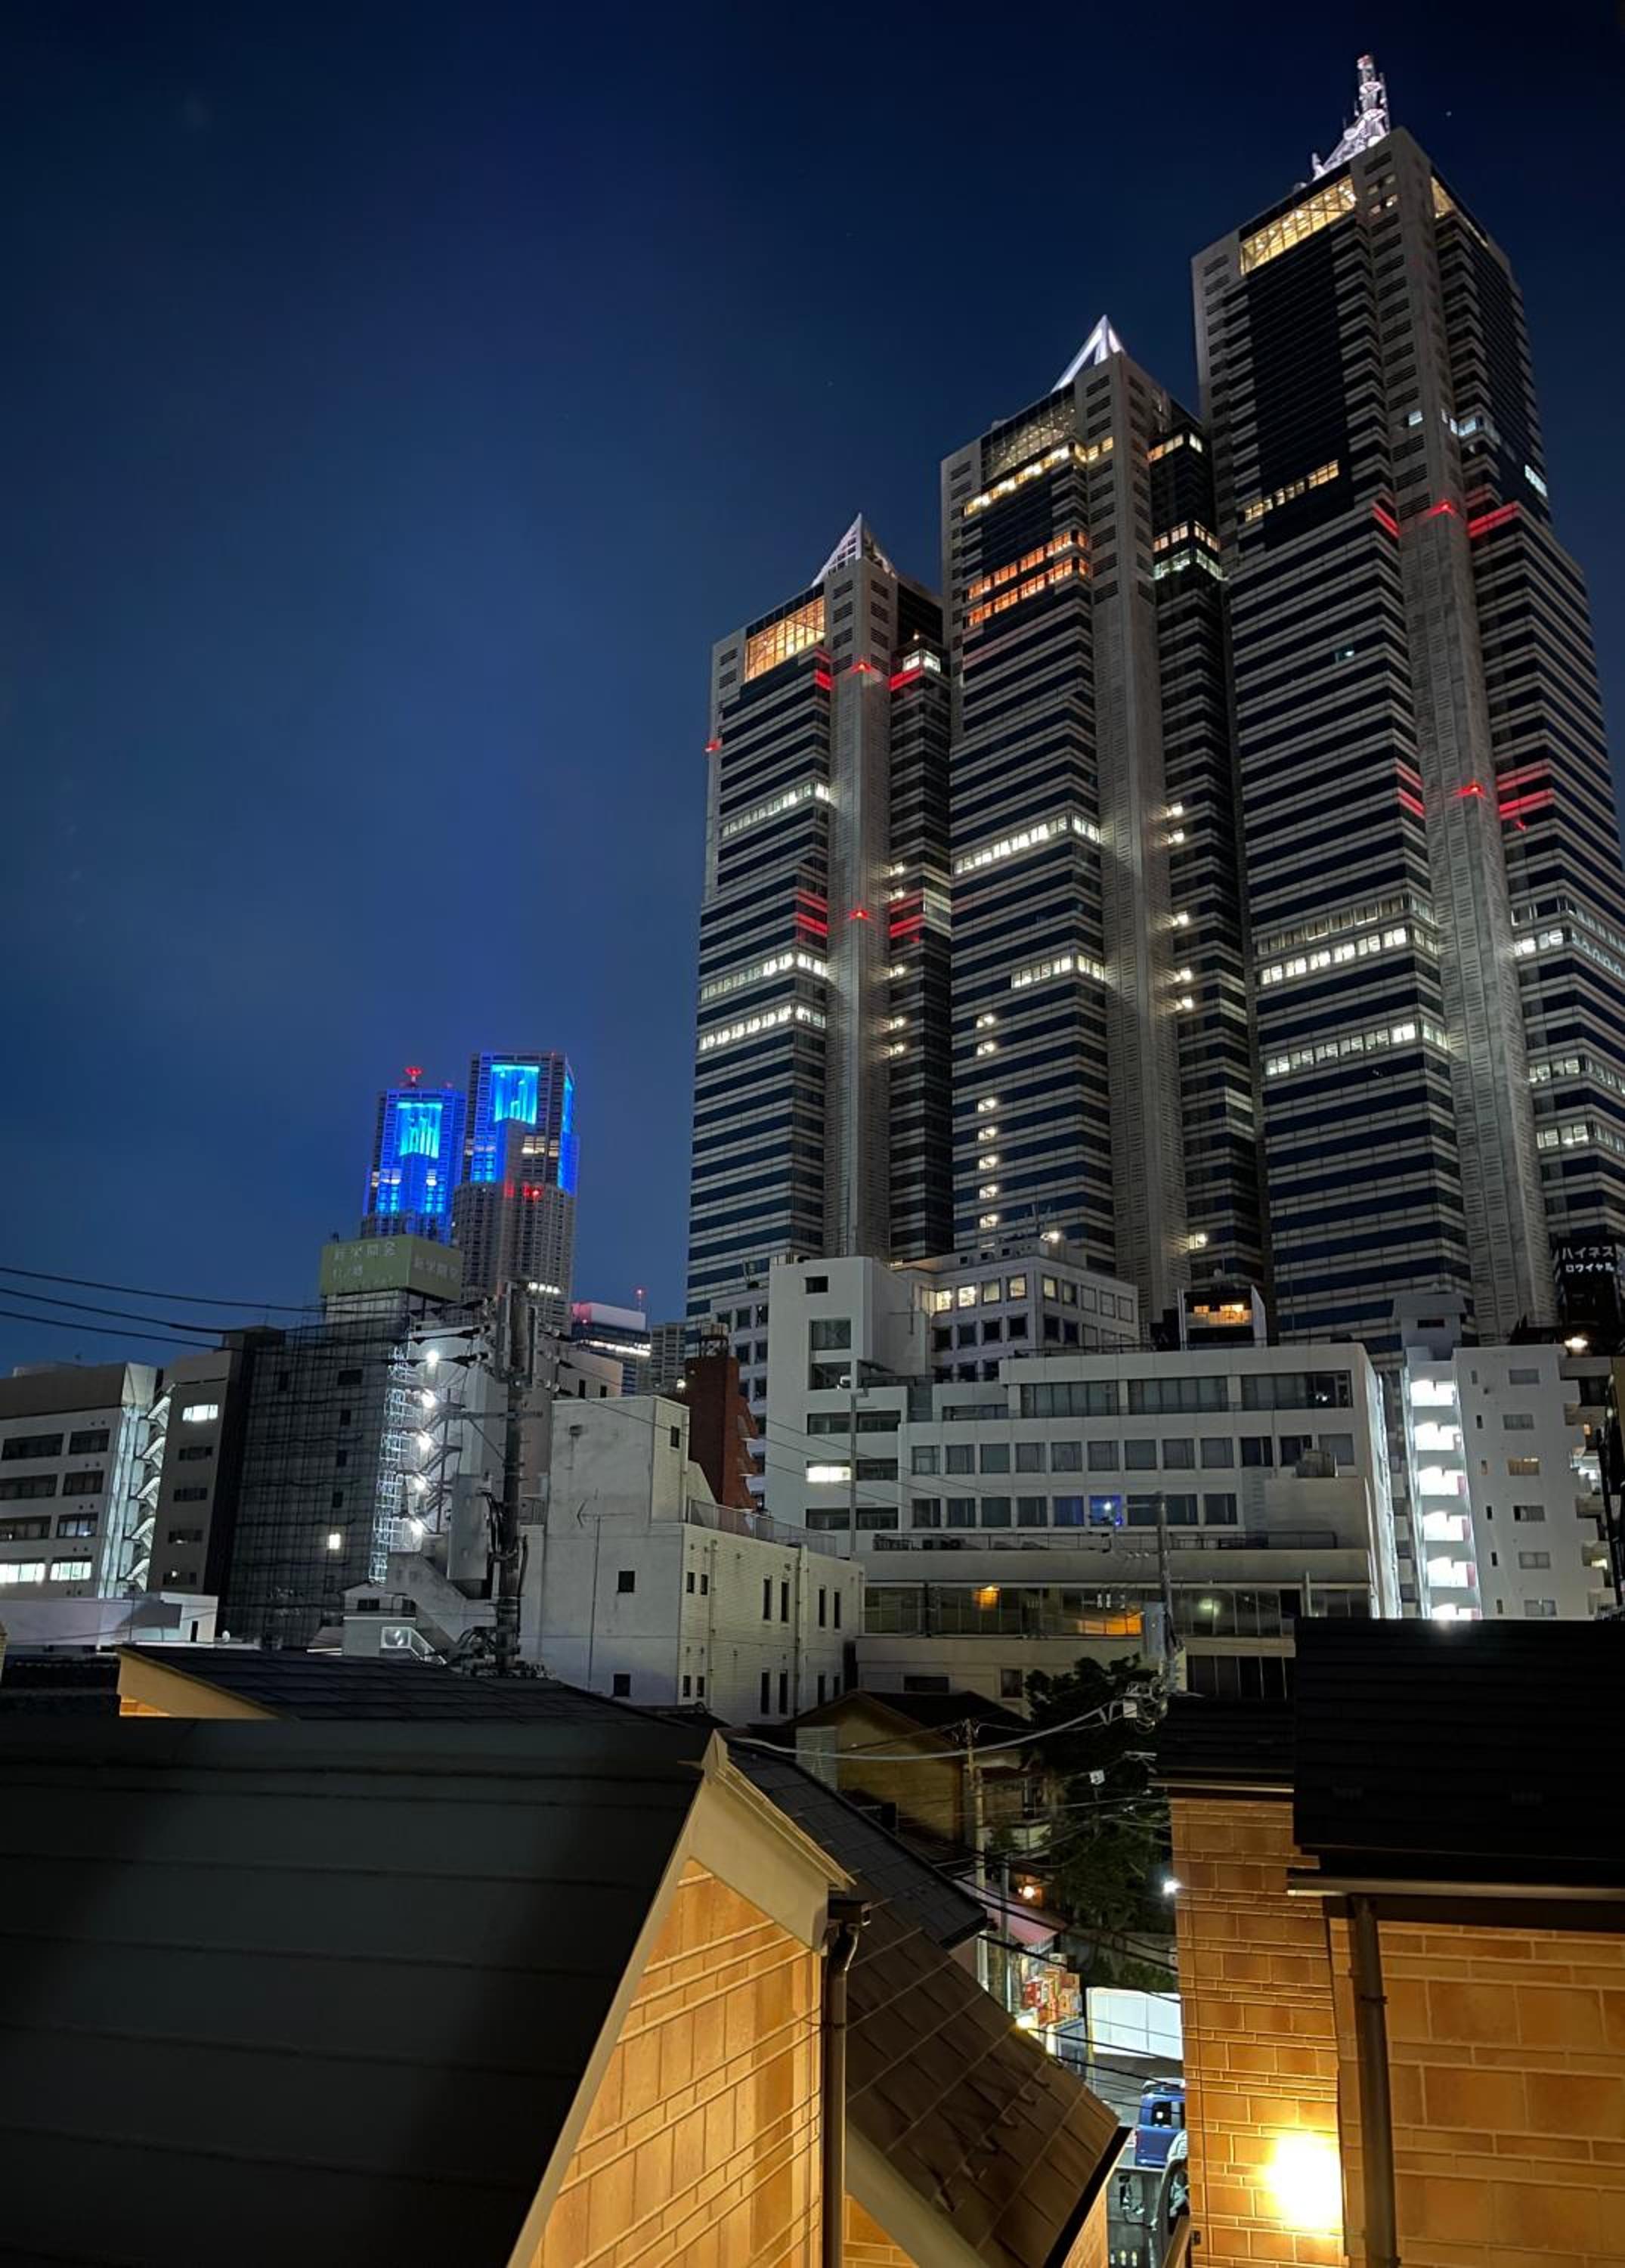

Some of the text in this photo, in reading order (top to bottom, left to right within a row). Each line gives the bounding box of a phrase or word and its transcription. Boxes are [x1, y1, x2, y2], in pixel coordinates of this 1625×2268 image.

[1562, 1247, 1614, 1259] ハイネス
[1565, 1262, 1615, 1273] ロワイヤル
